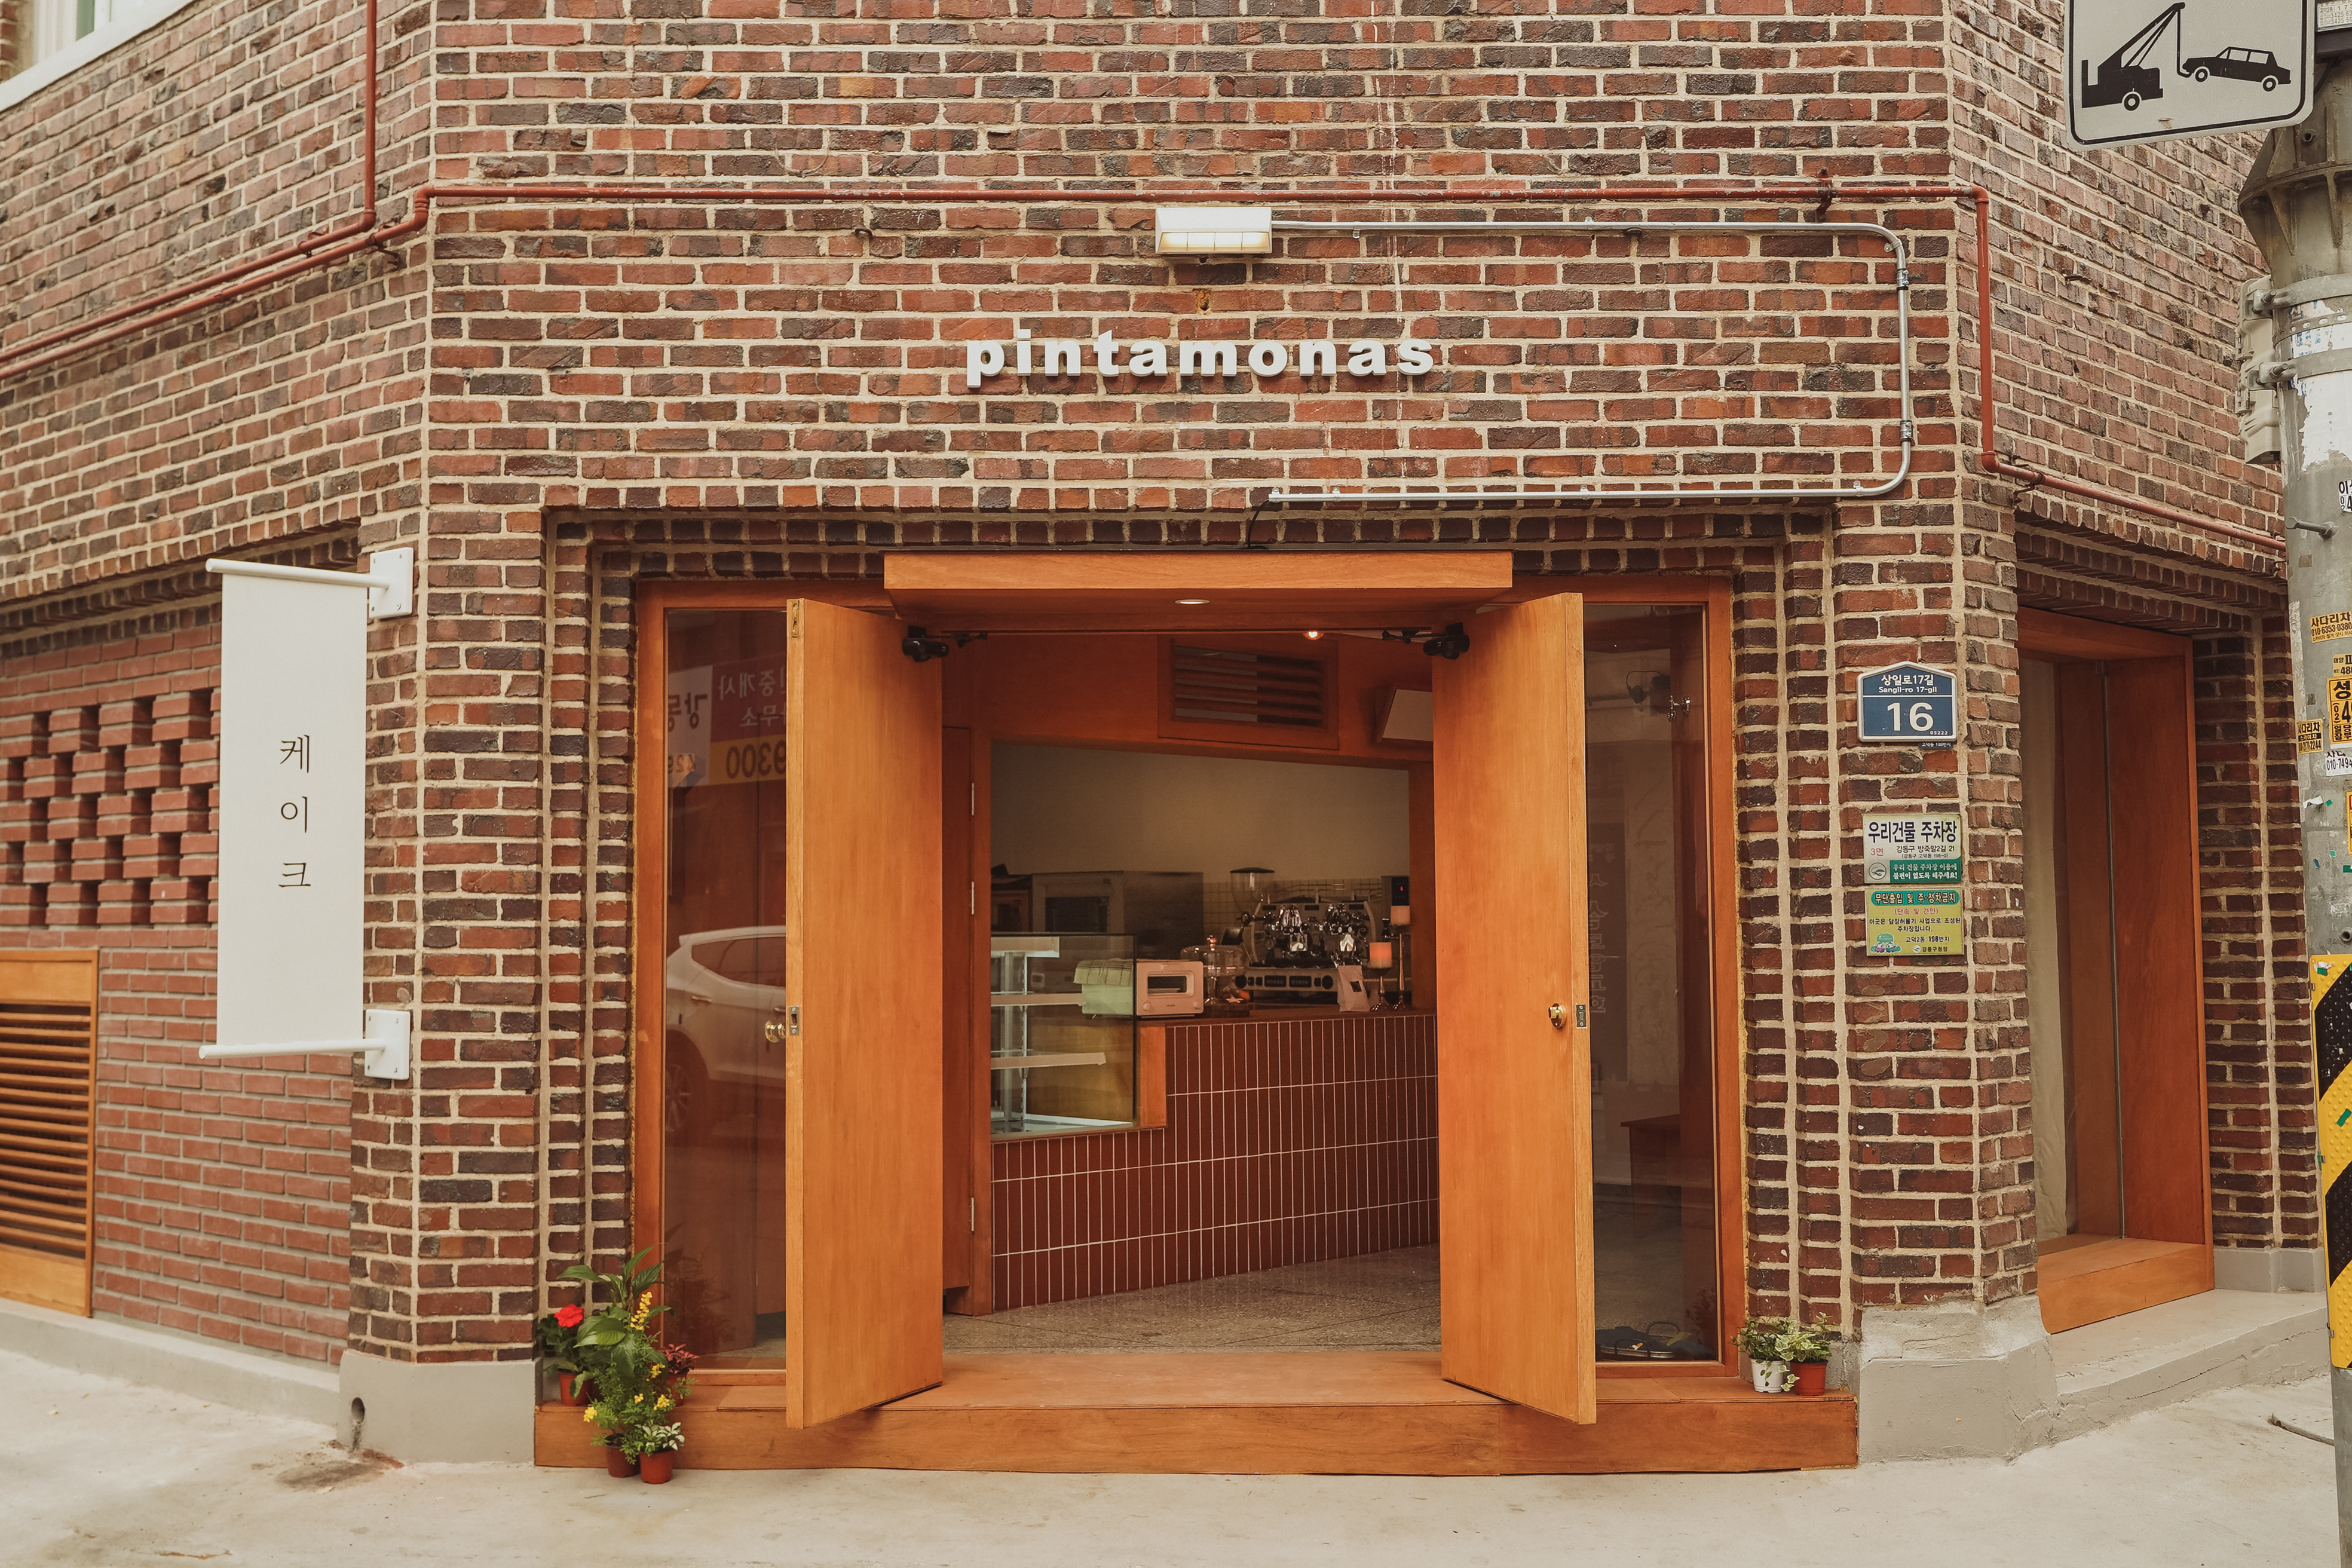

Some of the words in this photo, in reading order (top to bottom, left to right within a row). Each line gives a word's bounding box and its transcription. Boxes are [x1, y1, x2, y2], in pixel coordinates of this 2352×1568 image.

[966, 329, 1435, 388] pintamonas
[2311, 612, 2351, 627] 사다리차
[1881, 674, 1934, 686] 상일로17길
[1887, 702, 1934, 731] 16
[278, 734, 311, 887] 케이크
[1868, 821, 1916, 843] 우리건물
[1921, 820, 1957, 843] 주차장
[1870, 847, 1884, 856] 3면
[1896, 845, 1915, 853] 강동구
[1875, 893, 1903, 904] 무단출입
[1906, 892, 1914, 904] 및
